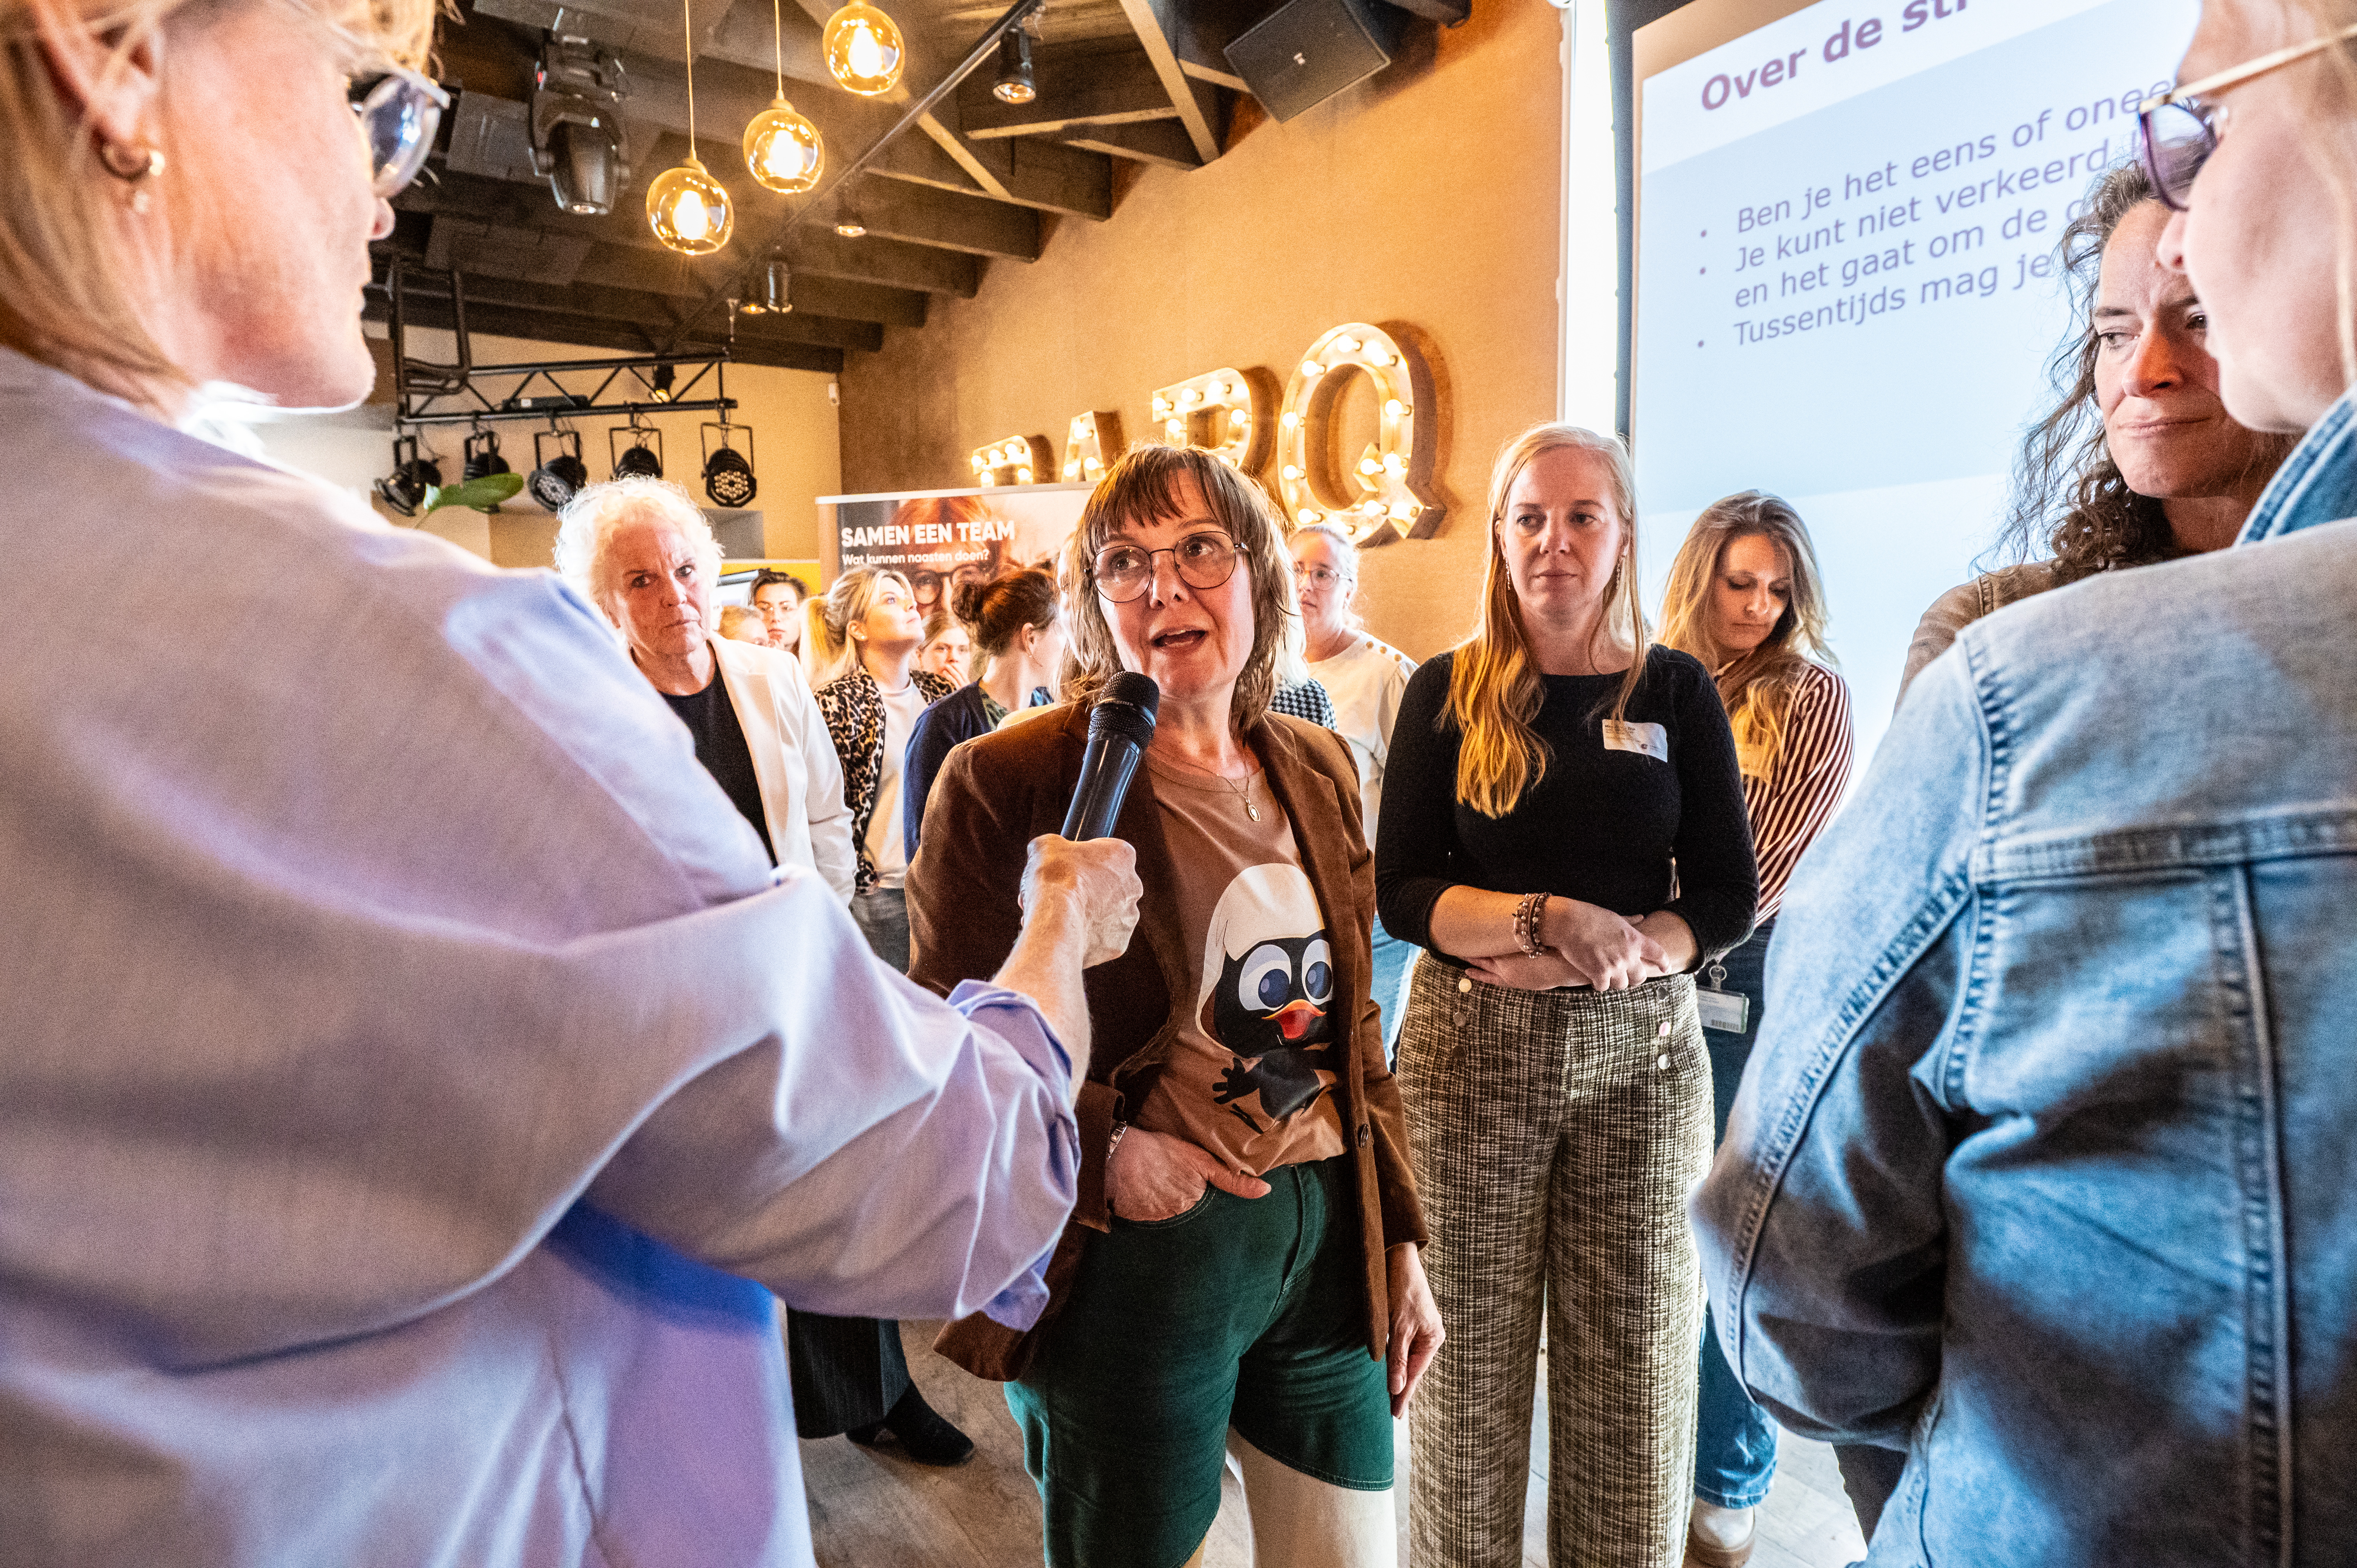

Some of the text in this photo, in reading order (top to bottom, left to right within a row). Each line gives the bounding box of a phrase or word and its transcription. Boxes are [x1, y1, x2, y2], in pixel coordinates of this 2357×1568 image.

[1701, 47, 1807, 110] Over
[1823, 18, 1883, 63] de
[1735, 247, 1765, 272] Je
[1777, 219, 1846, 260] kunt
[1858, 196, 1922, 237] niet
[1936, 138, 2109, 214] verkeerd
[1738, 200, 1790, 233] Ben
[1801, 187, 1831, 220] je
[1845, 161, 1898, 200] het
[1911, 134, 1996, 179] eens
[2012, 108, 2053, 148] of
[1733, 253, 2052, 345] Tussentijds mag je
[1735, 283, 1768, 308] en
[1782, 262, 1829, 297] het
[1841, 239, 1915, 288] gaat
[1929, 225, 1984, 258] om
[2002, 208, 2048, 240] de
[841, 520, 1015, 547] SAMEN EEN TEAM
[842, 549, 989, 565] Wat kunnen naasten doen?
